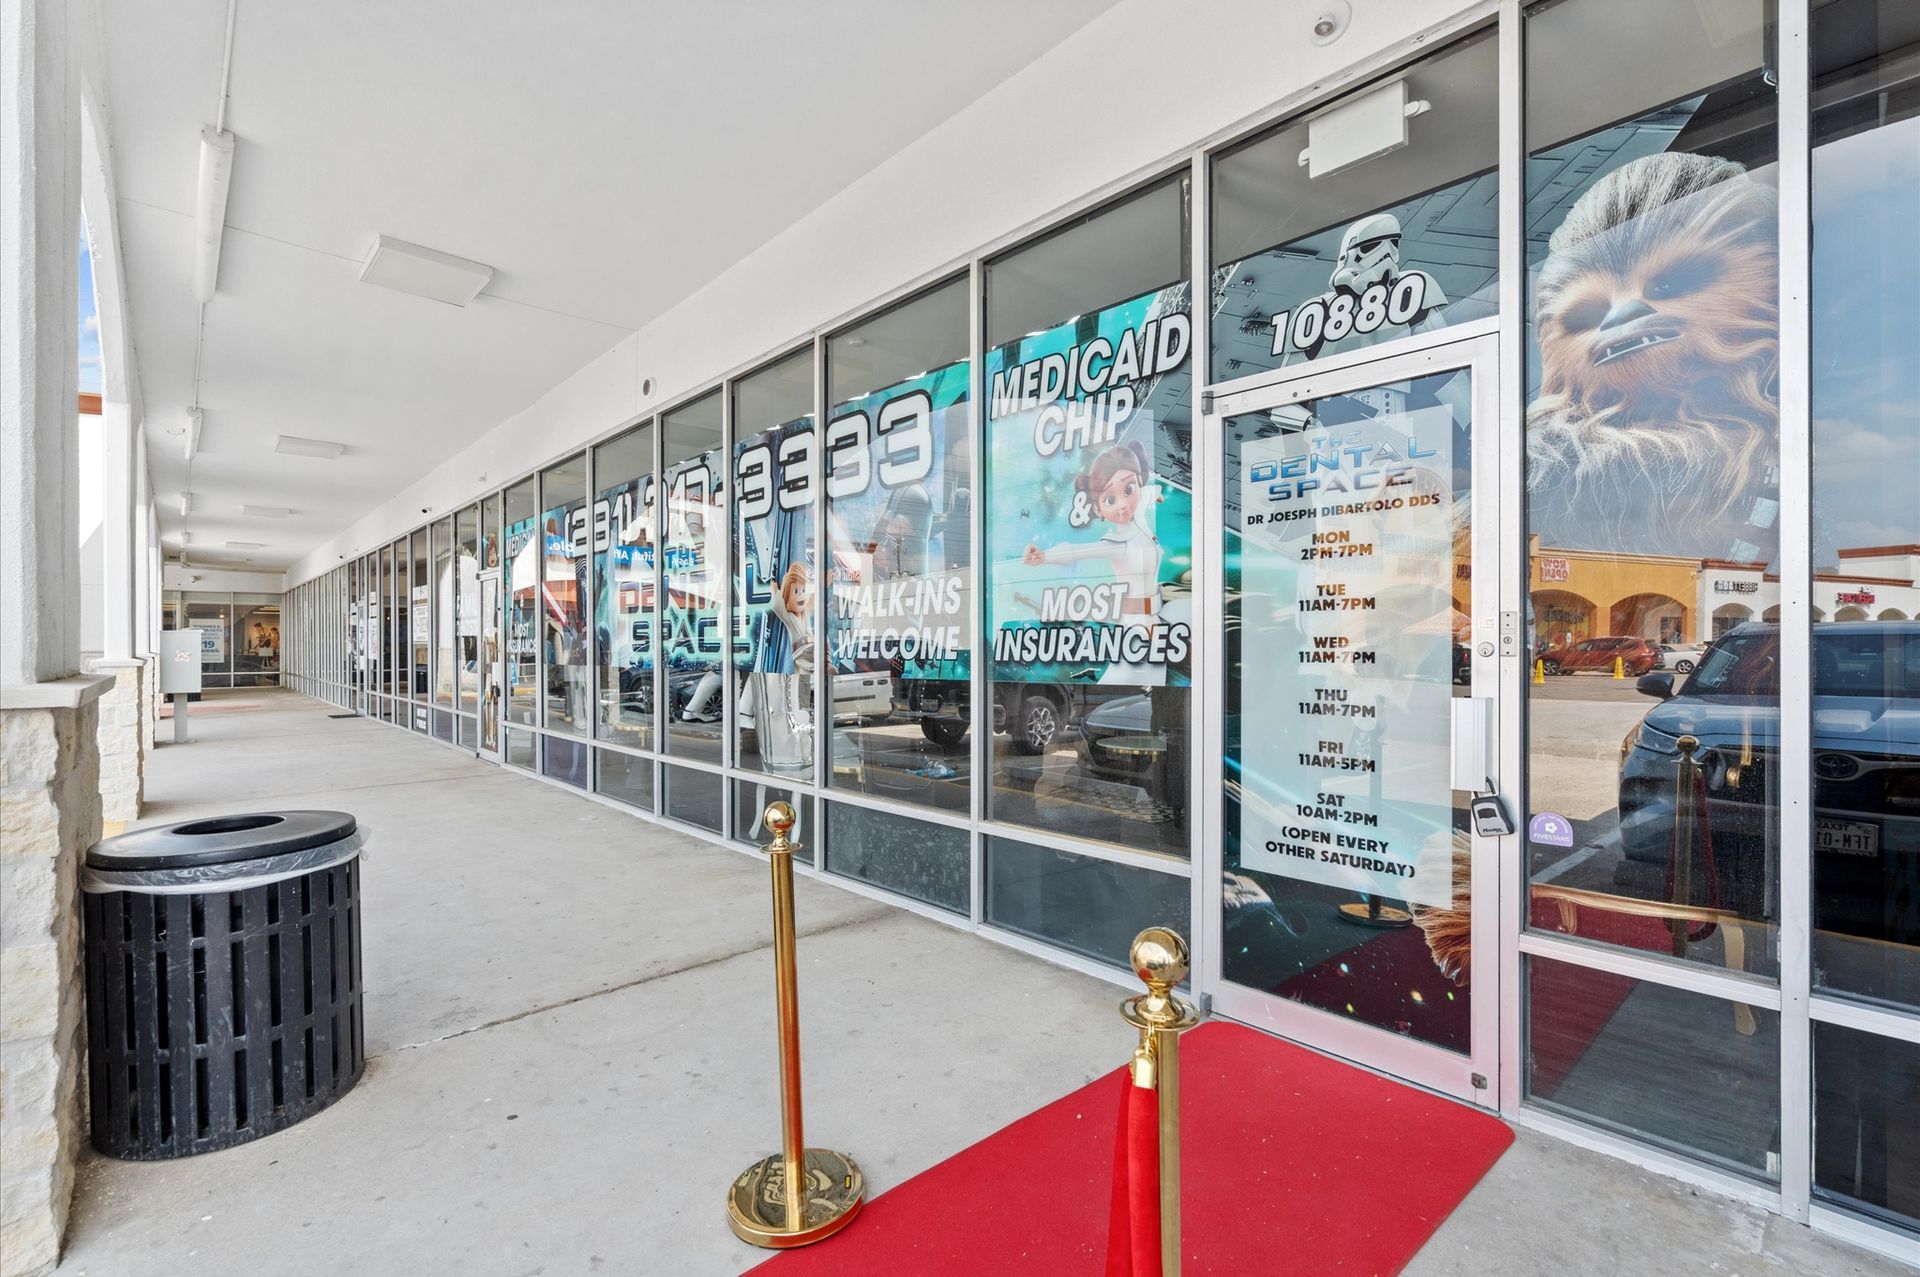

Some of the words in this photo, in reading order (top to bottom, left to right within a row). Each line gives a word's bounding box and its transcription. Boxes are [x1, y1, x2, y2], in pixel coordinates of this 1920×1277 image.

[1270, 272, 1426, 357] 10880
[989, 314, 1192, 421] MEDICAID
[1034, 385, 1137, 457] CHIP
[1312, 431, 1363, 450] THE
[1250, 437, 1437, 482] DENTAL
[1268, 464, 1414, 502] SPACE
[1068, 490, 1092, 528] &
[1247, 512, 1264, 526] DR
[1267, 508, 1318, 524] JOESPH
[1321, 499, 1404, 518] DIBARTOLO
[1408, 493, 1441, 507] DDS
[1312, 530, 1351, 546] MON
[1300, 543, 1374, 561] 2PM-7PM
[836, 576, 963, 621] WALK-INS
[1040, 581, 1130, 625] MOST
[1316, 584, 1346, 597] TUE
[1299, 598, 1376, 612] 11AM-7PM
[632, 615, 751, 654] SPACE
[837, 625, 961, 661] WELCOME
[994, 623, 1192, 664] INSURANCES
[1313, 636, 1349, 649] WED
[1299, 651, 1376, 664] 11AM-7PM
[1314, 689, 1348, 702] THU
[1299, 702, 1376, 718] 11AM-7PM
[1318, 741, 1344, 755] FRI
[1299, 753, 1376, 773] 11AM-5PM
[1316, 792, 1345, 808] SAT
[1296, 804, 1378, 828] 10AM-2PM
[1281, 825, 1331, 847] (OPEN
[1336, 833, 1389, 855] EVERY
[1533, 832, 1570, 843] FIVESTARS
[1264, 840, 1316, 861] OTHER
[1320, 849, 1416, 879] SATURDAY)
